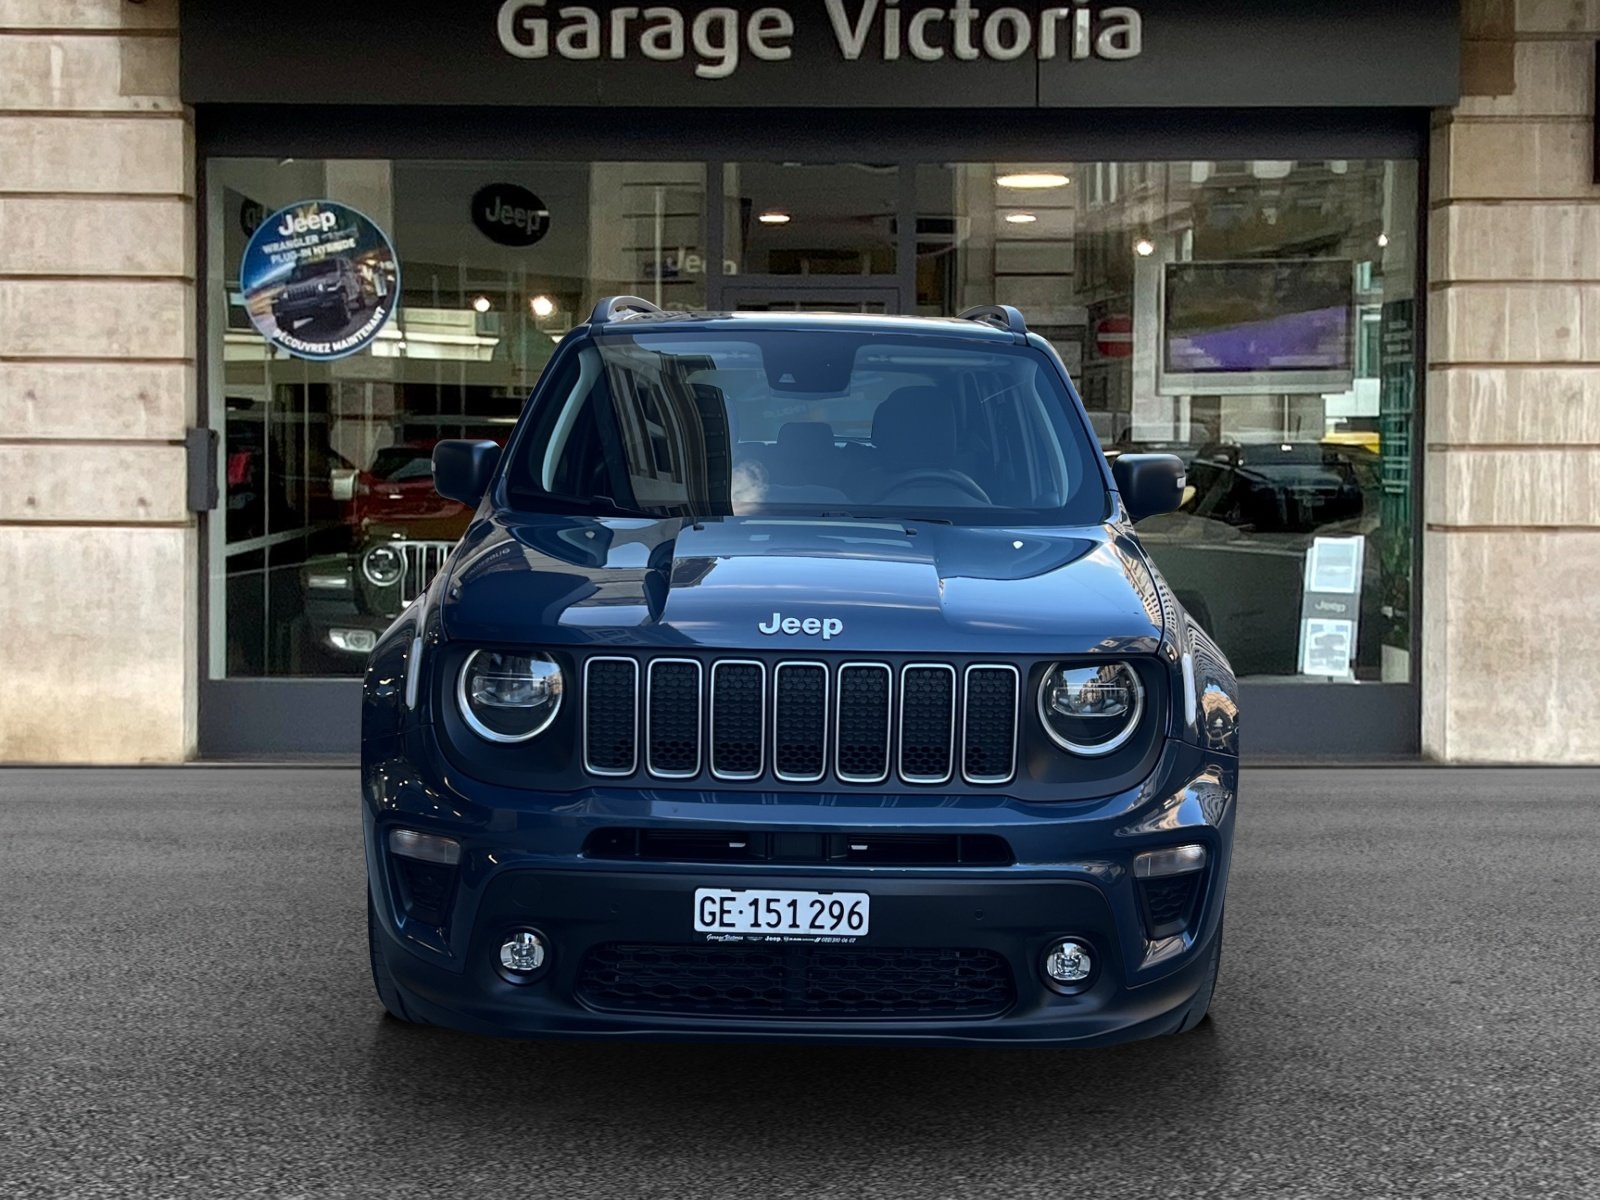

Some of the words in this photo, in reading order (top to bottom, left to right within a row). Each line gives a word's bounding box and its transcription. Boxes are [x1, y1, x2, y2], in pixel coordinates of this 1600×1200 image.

[498, 0, 794, 79] Garage
[824, 0, 1143, 61] Victoria
[278, 211, 337, 236] Jeep
[485, 196, 540, 235] Jeep
[262, 234, 320, 254] WRANGLER
[332, 305, 386, 351] MAINTENANT
[757, 612, 844, 640] Jeep
